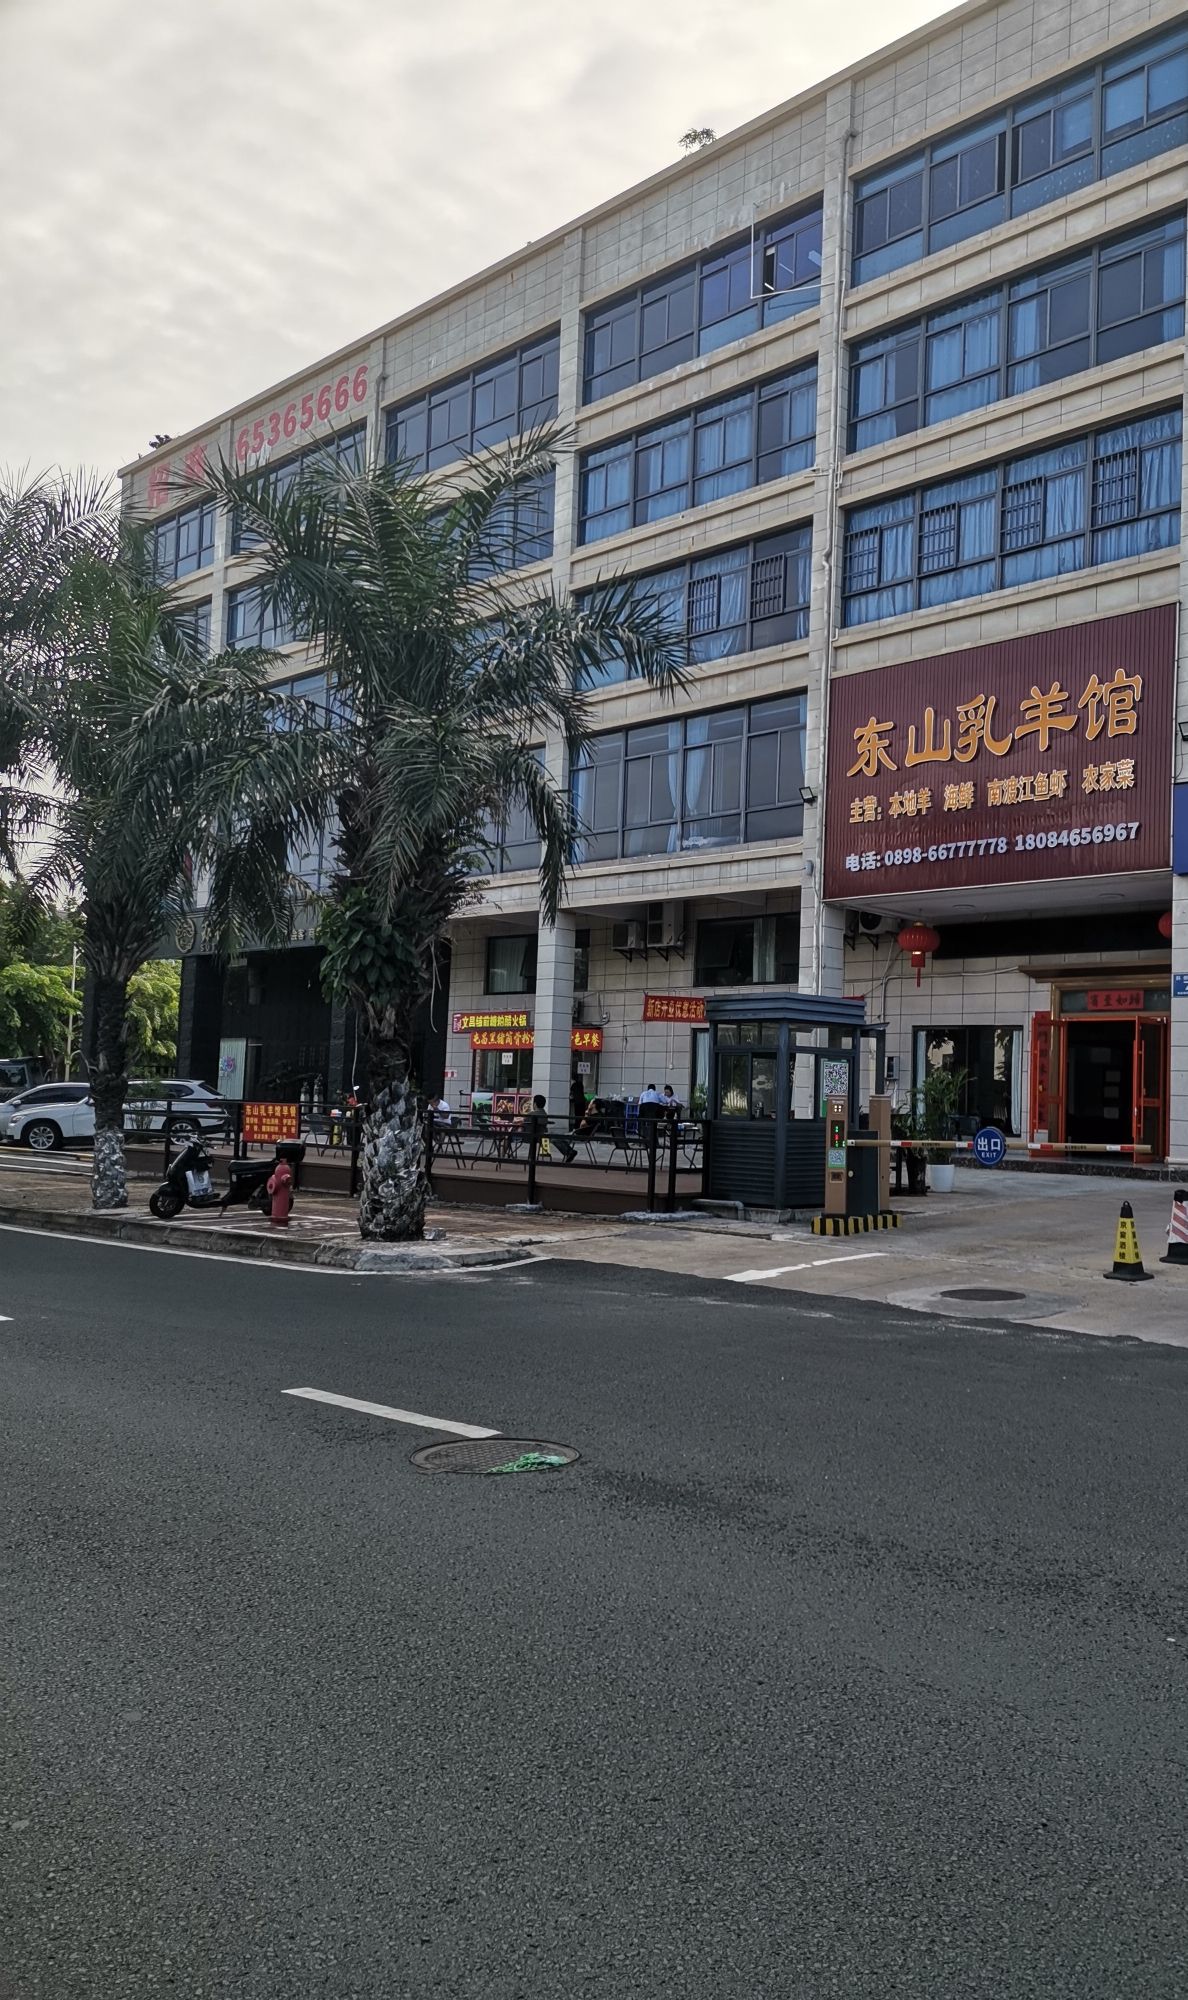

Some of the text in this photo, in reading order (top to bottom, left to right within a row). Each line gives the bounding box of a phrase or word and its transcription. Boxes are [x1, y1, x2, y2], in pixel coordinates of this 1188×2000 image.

[236, 365, 368, 462] 65365666
[846, 668, 1143, 777] 东山乳羊馆
[888, 787, 932, 819] 本地羊
[943, 781, 975, 813] 海鲜
[987, 769, 1068, 807] 南渡江鱼虾
[1082, 759, 1136, 794] 农家菜
[1014, 822, 1140, 851] 18084656967
[977, 1136, 1001, 1151] 出口
